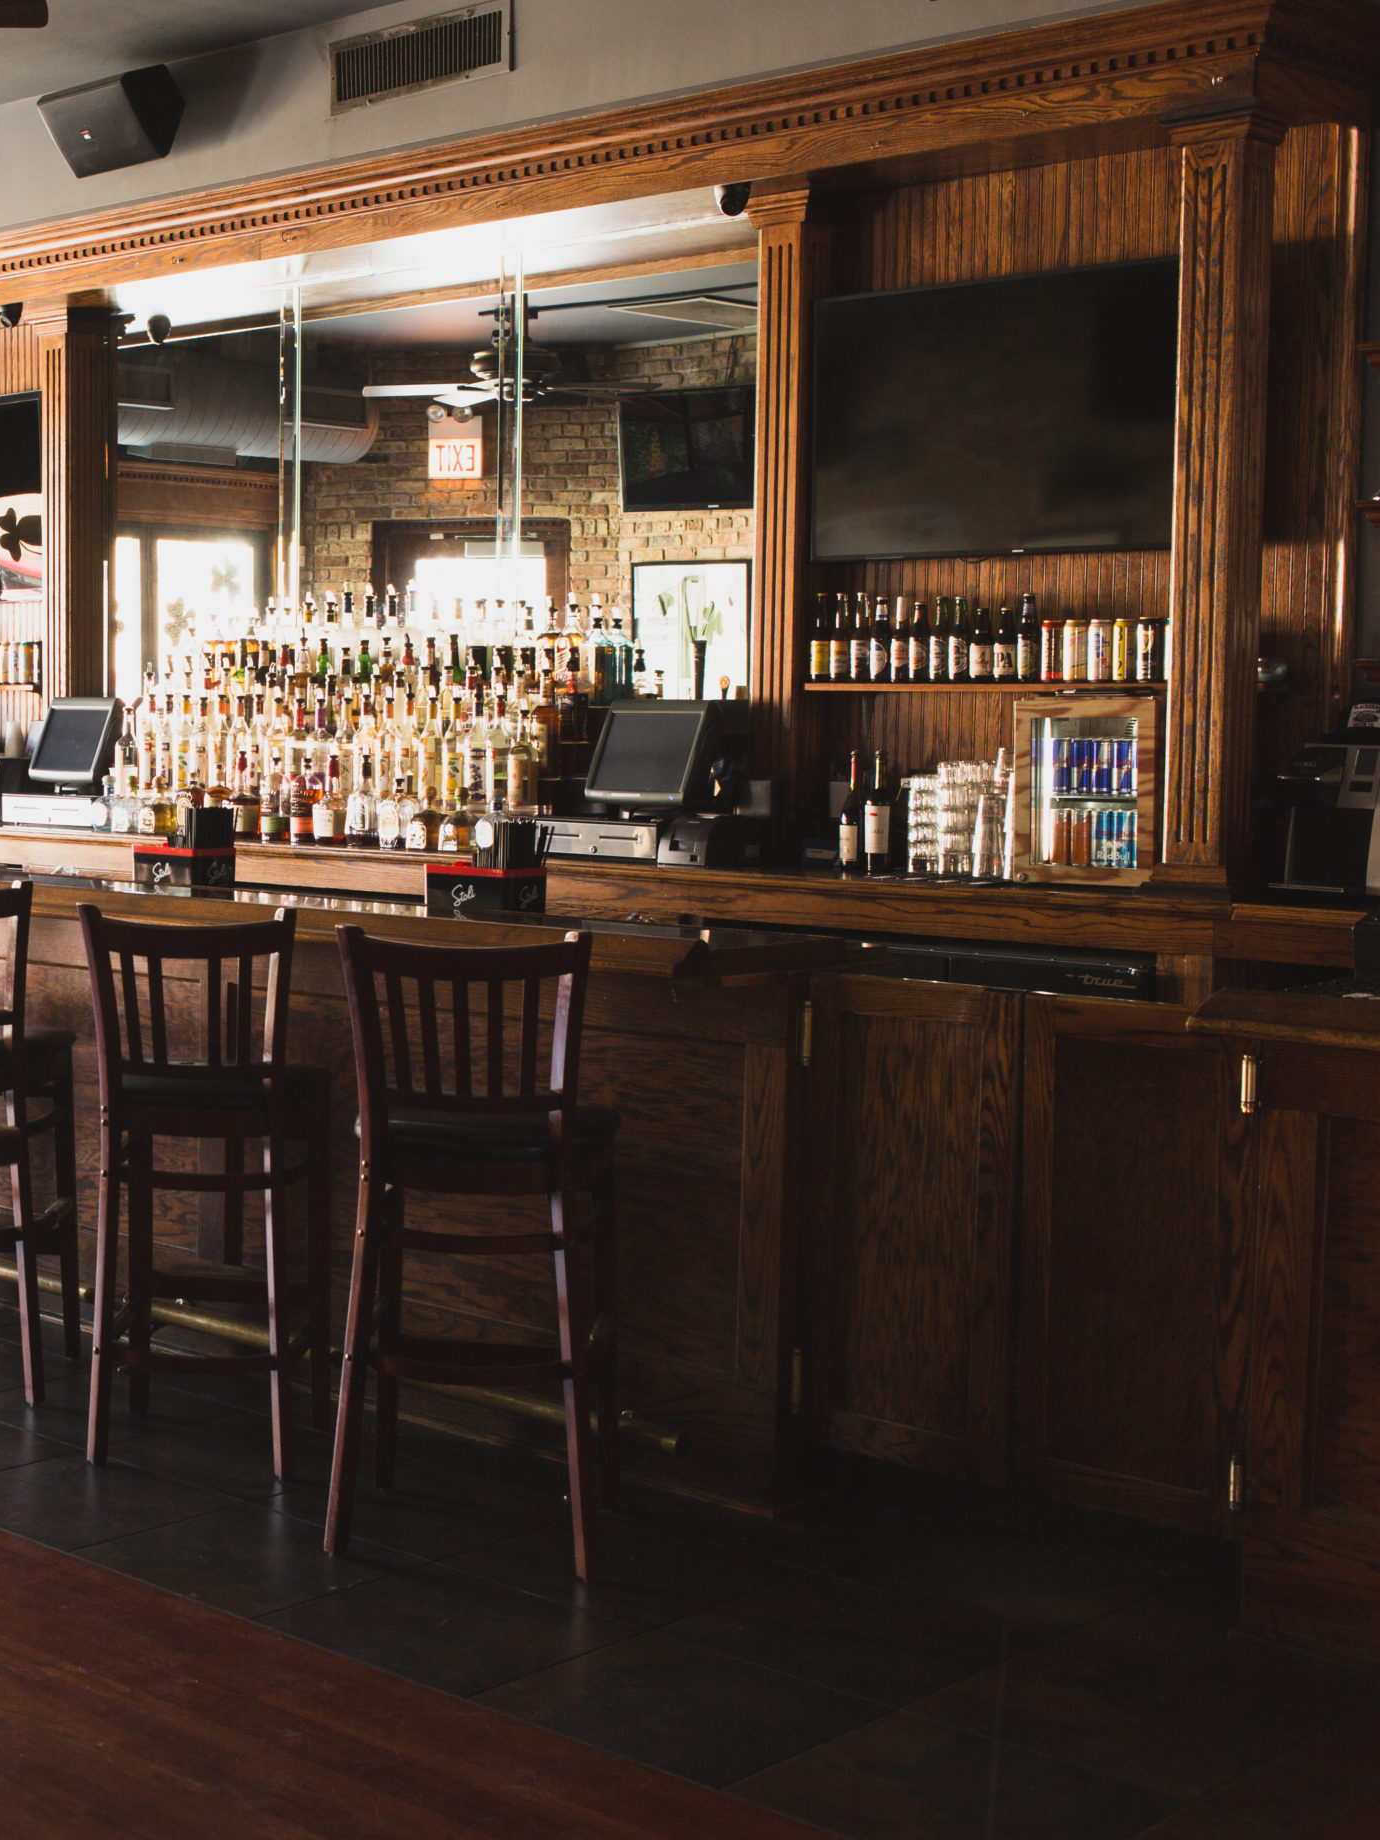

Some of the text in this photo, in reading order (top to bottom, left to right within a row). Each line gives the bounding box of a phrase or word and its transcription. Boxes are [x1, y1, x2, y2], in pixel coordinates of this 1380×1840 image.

[152, 861, 172, 883] Stoli
[451, 883, 476, 907] Stoli
[1082, 972, 1125, 987] true
